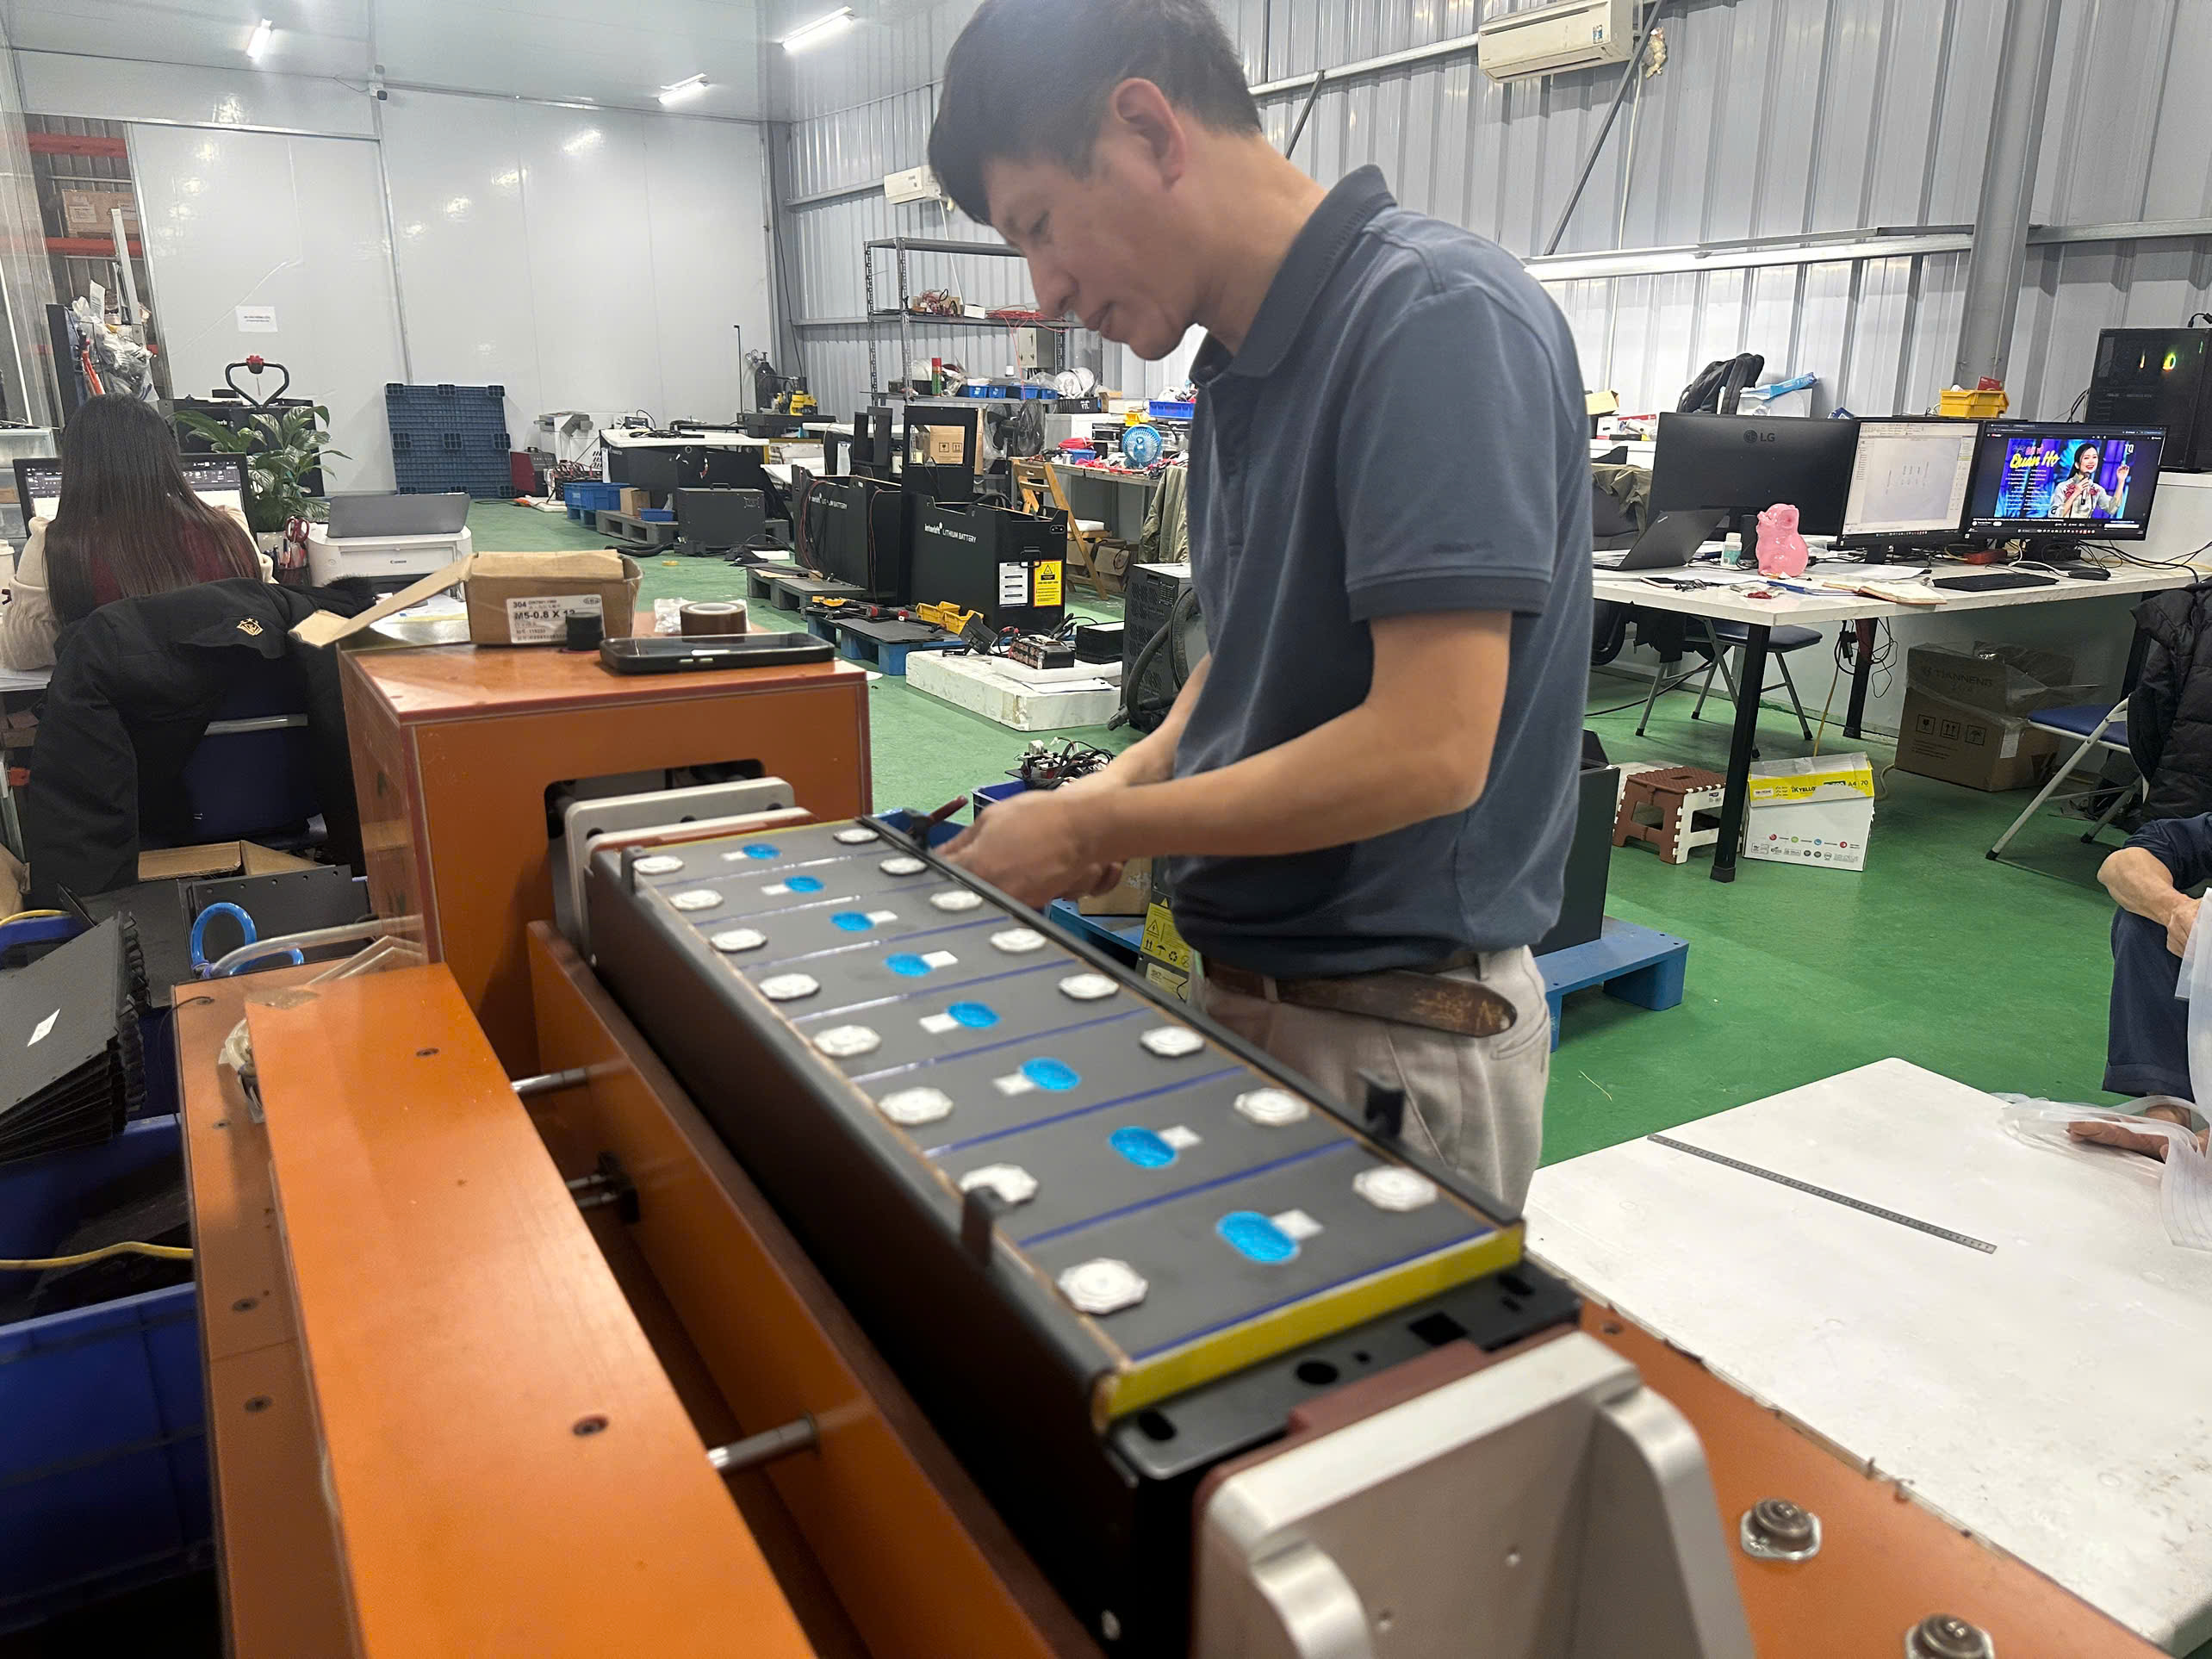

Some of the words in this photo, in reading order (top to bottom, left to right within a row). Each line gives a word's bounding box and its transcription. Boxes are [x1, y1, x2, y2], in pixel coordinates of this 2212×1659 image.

[1760, 432, 1776, 442] LG
[958, 532, 978, 544] BATTERY
[515, 611, 550, 620] M5-0.8
